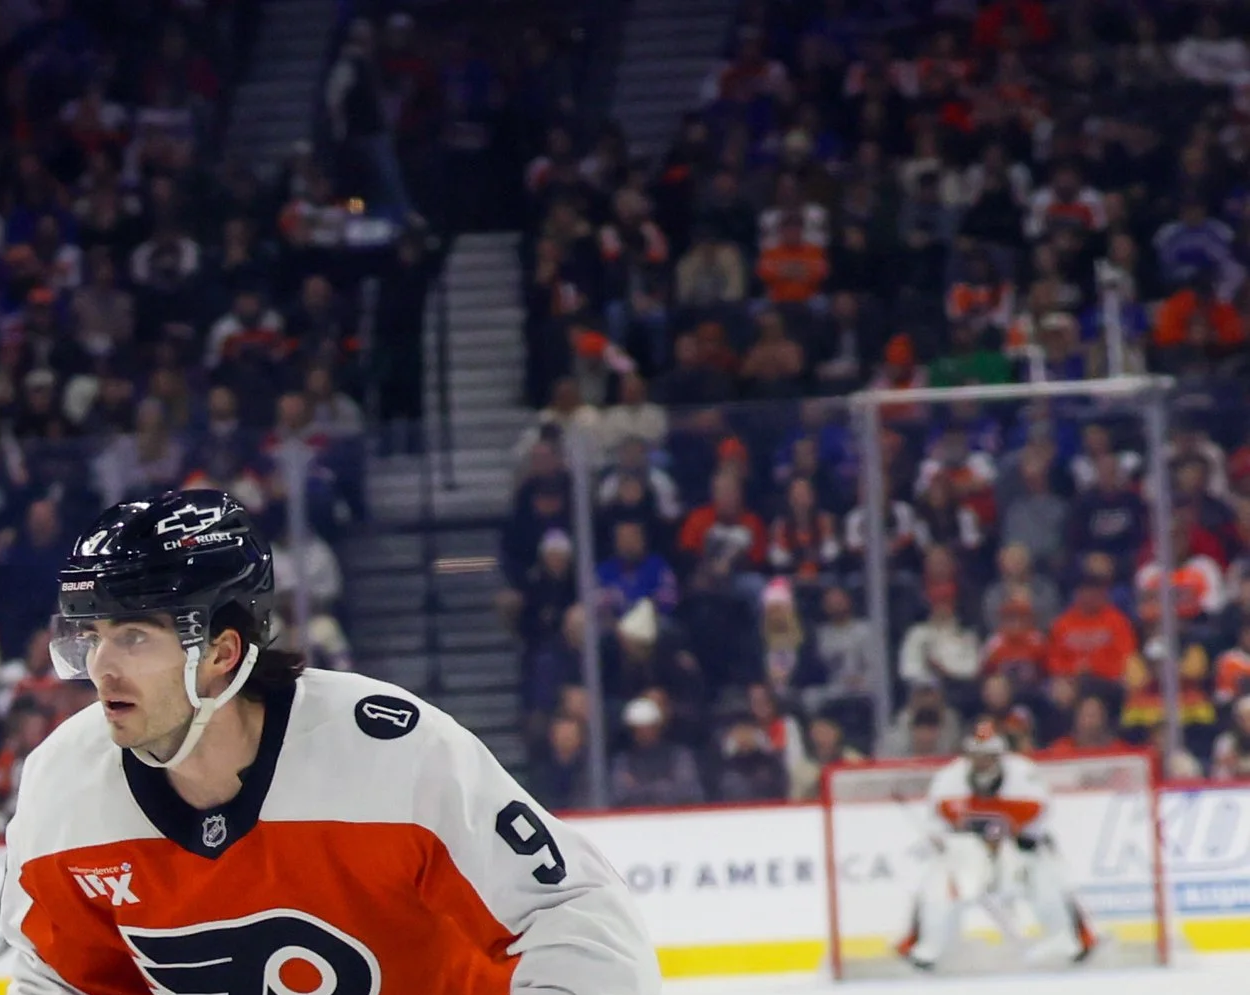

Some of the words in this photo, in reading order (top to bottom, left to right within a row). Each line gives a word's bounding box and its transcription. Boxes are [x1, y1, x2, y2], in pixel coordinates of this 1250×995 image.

[362, 702, 413, 728] 1
[495, 800, 567, 885] 9
[695, 853, 895, 889] AMERCA
